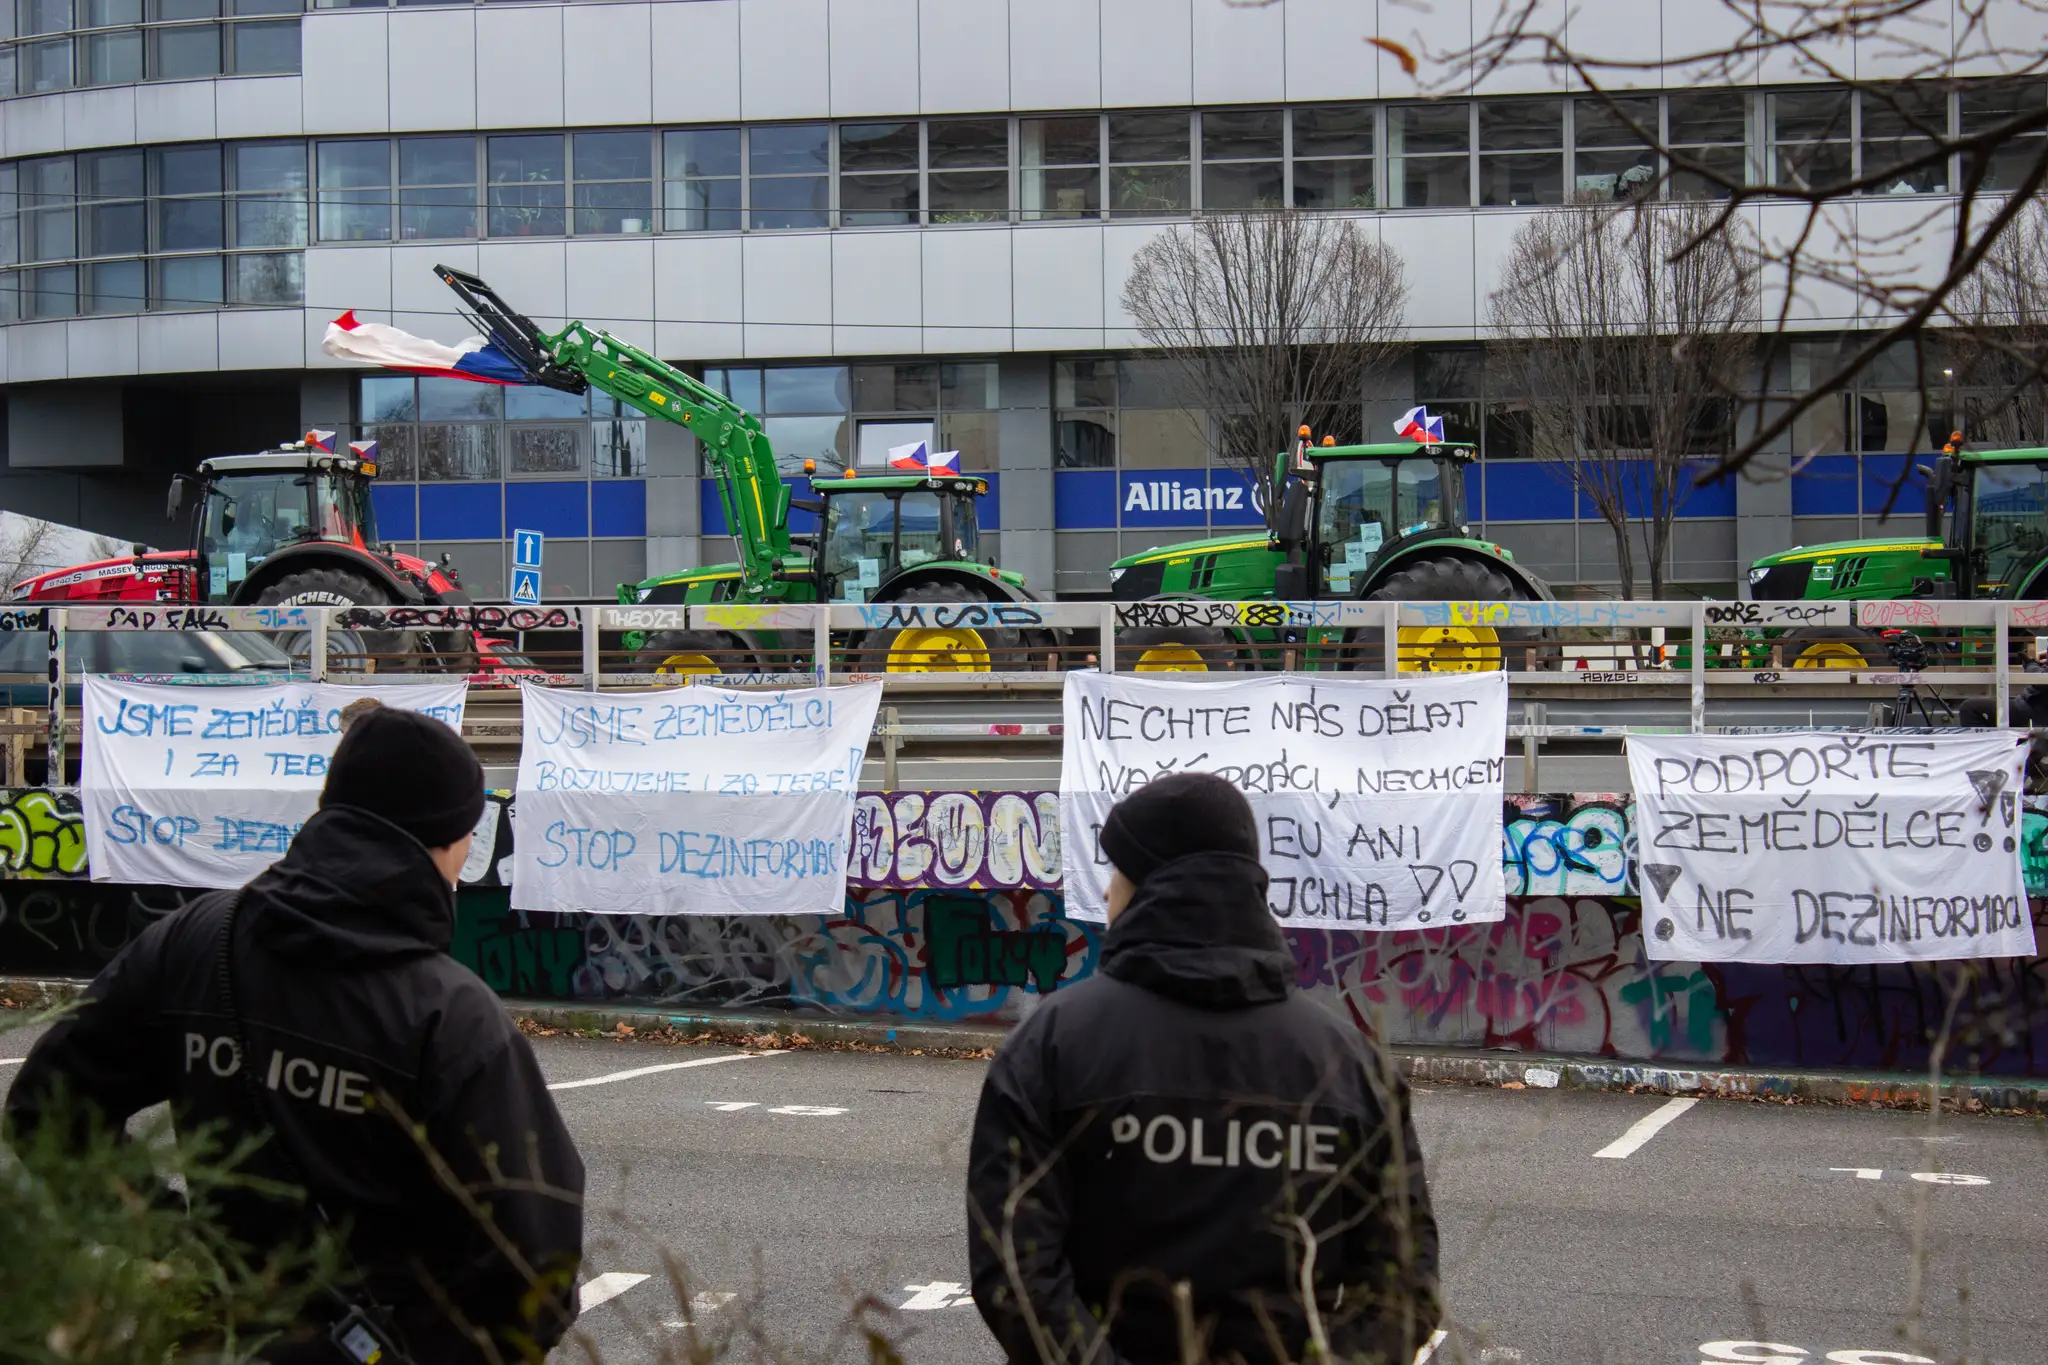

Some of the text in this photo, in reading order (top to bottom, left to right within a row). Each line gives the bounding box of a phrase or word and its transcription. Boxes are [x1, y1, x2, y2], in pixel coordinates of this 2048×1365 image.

[1124, 481, 1244, 512] Allianz
[98, 565, 132, 578] MASSEY
[98, 696, 341, 739] JSME ZEMĚDĚLC
[537, 693, 833, 749] JSME ZEMĚDĚLCI
[1081, 686, 1478, 742] NECHTE NÁS DĚLAT
[164, 748, 334, 778] I ZA TEB
[535, 760, 691, 794] BOJUJEME
[718, 772, 761, 796] ZA
[1654, 735, 1936, 800] PODPOŘTE
[105, 804, 201, 847] STOP
[536, 820, 637, 873] STOP
[1268, 816, 1421, 861] EU ANI
[1696, 883, 1755, 941] NE
[185, 1032, 370, 1115] POICIE
[1105, 1113, 1341, 1173] POLICIE
